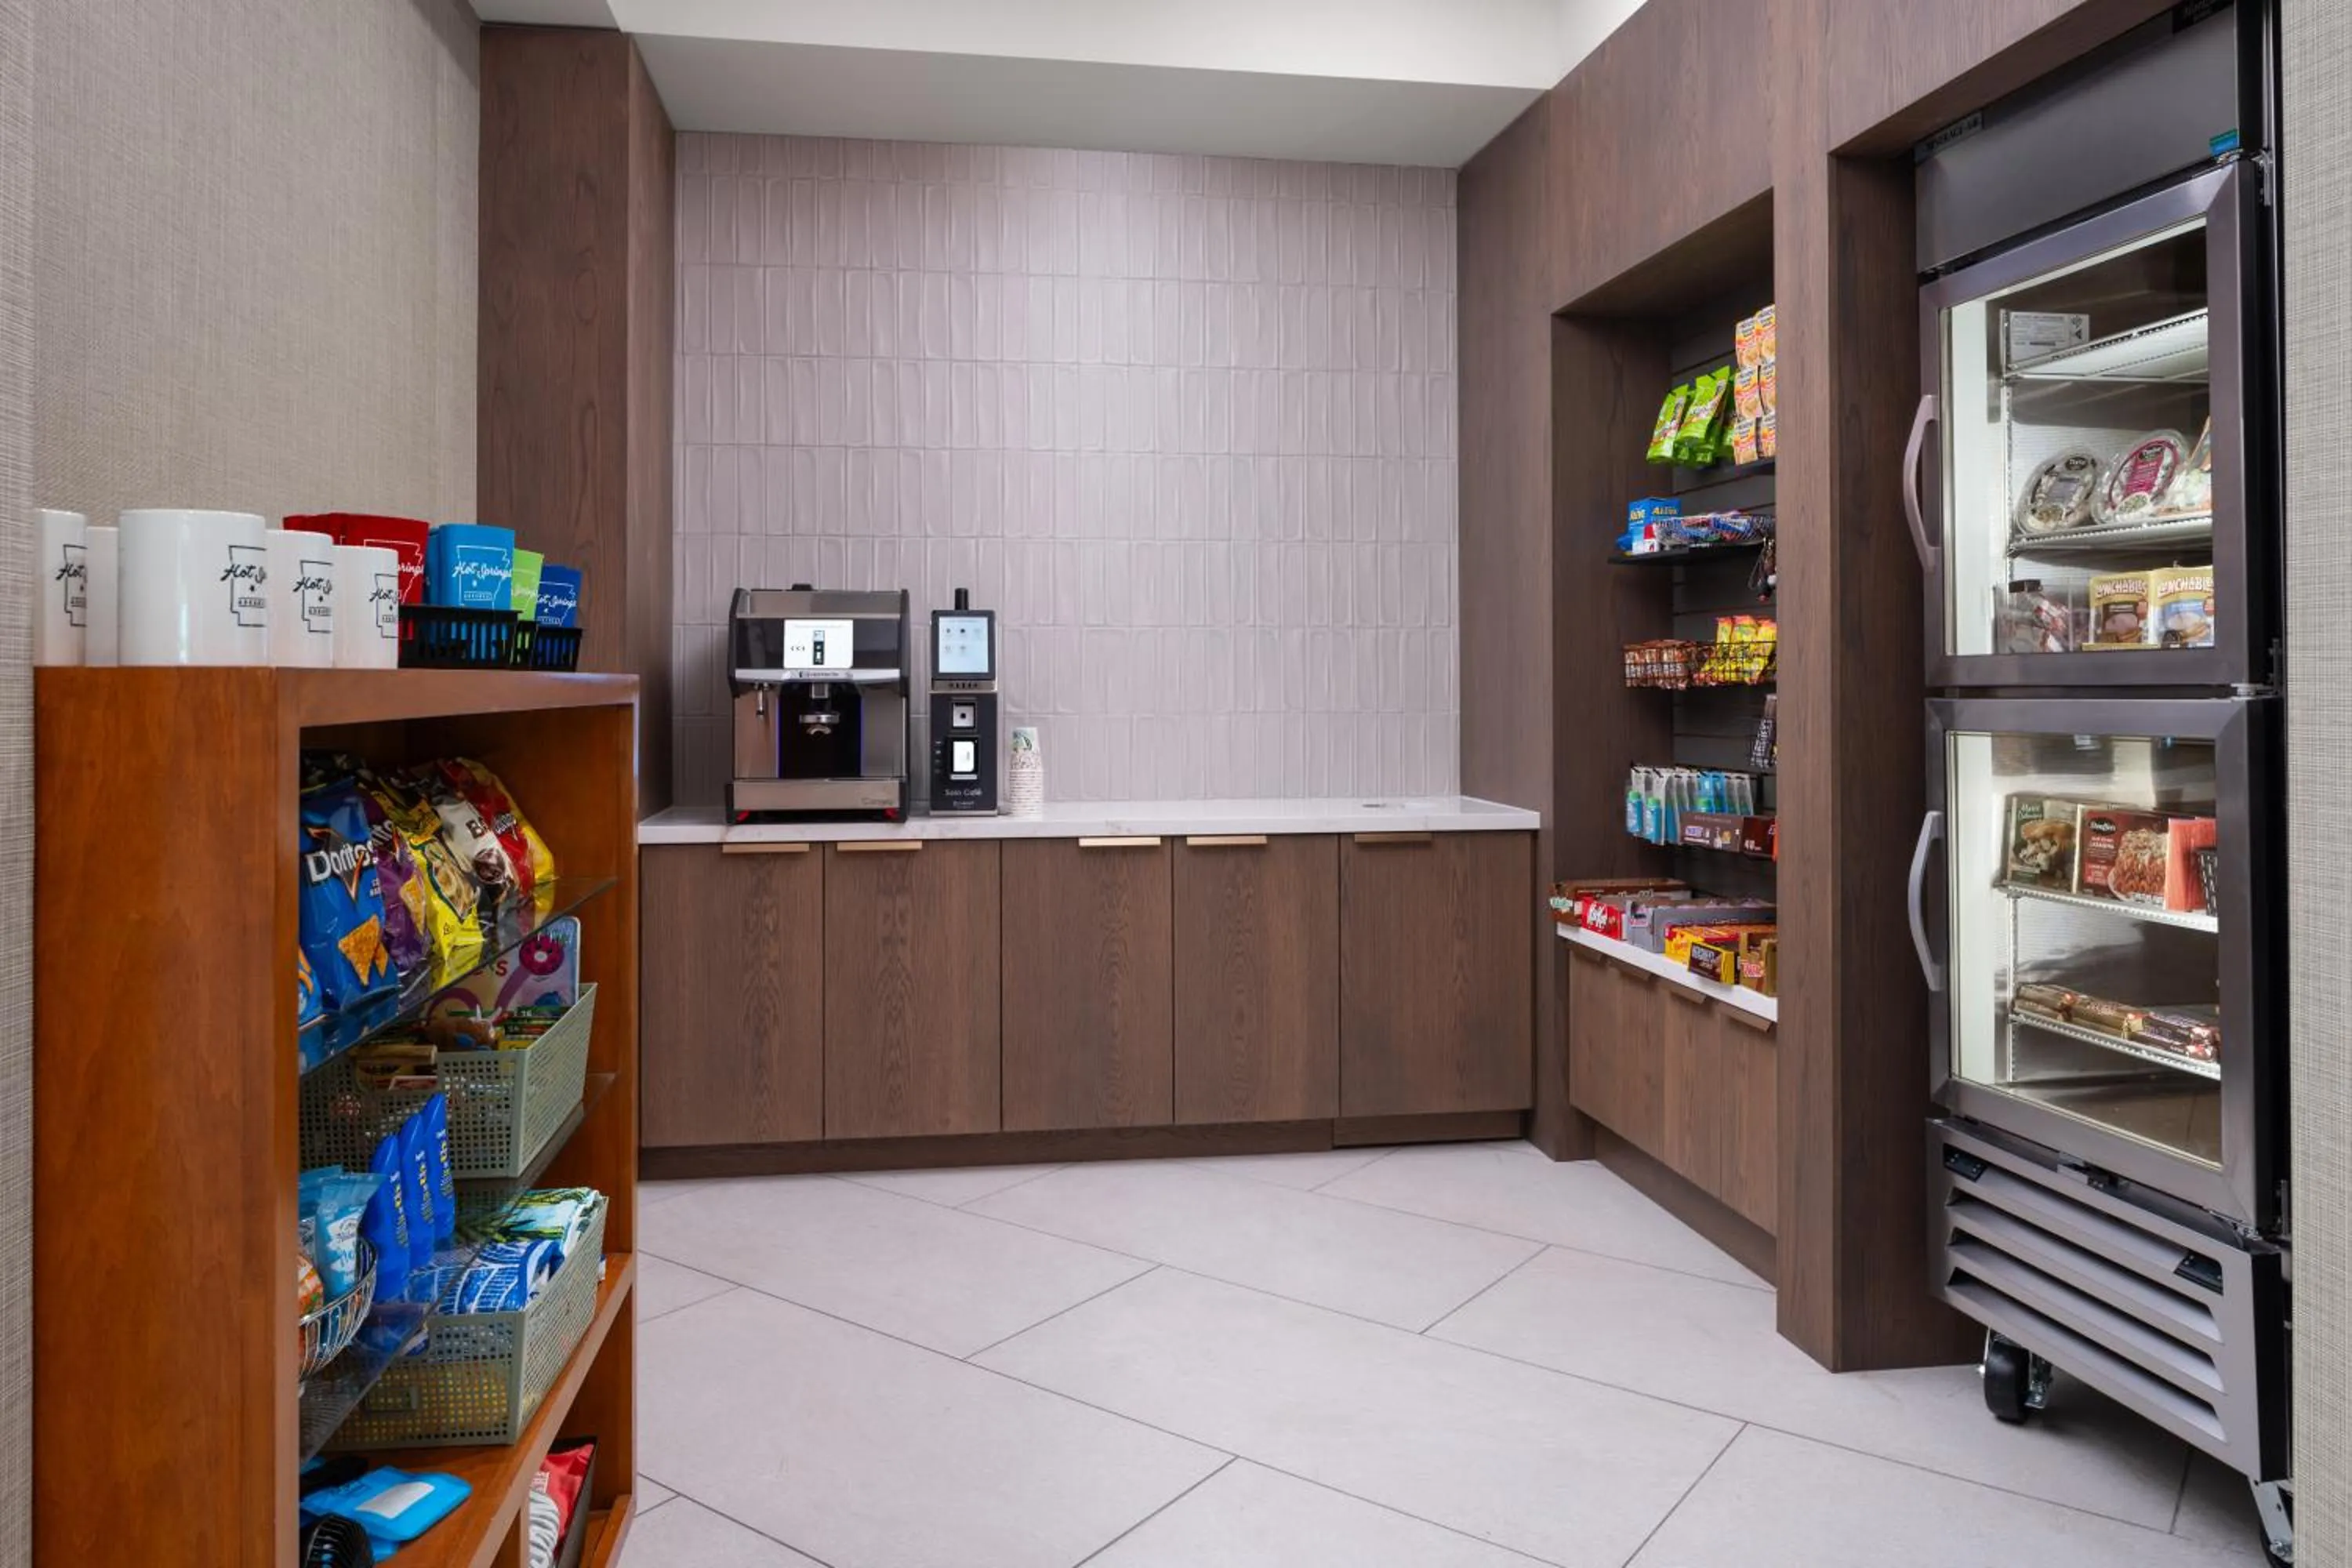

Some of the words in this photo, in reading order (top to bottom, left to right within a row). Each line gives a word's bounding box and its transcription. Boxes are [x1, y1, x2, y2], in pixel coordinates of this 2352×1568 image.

[220, 564, 256, 581] Hot
[452, 562, 479, 578] Hot
[477, 564, 512, 580] Springs
[292, 576, 324, 592] Hot
[369, 588, 394, 602] Hot
